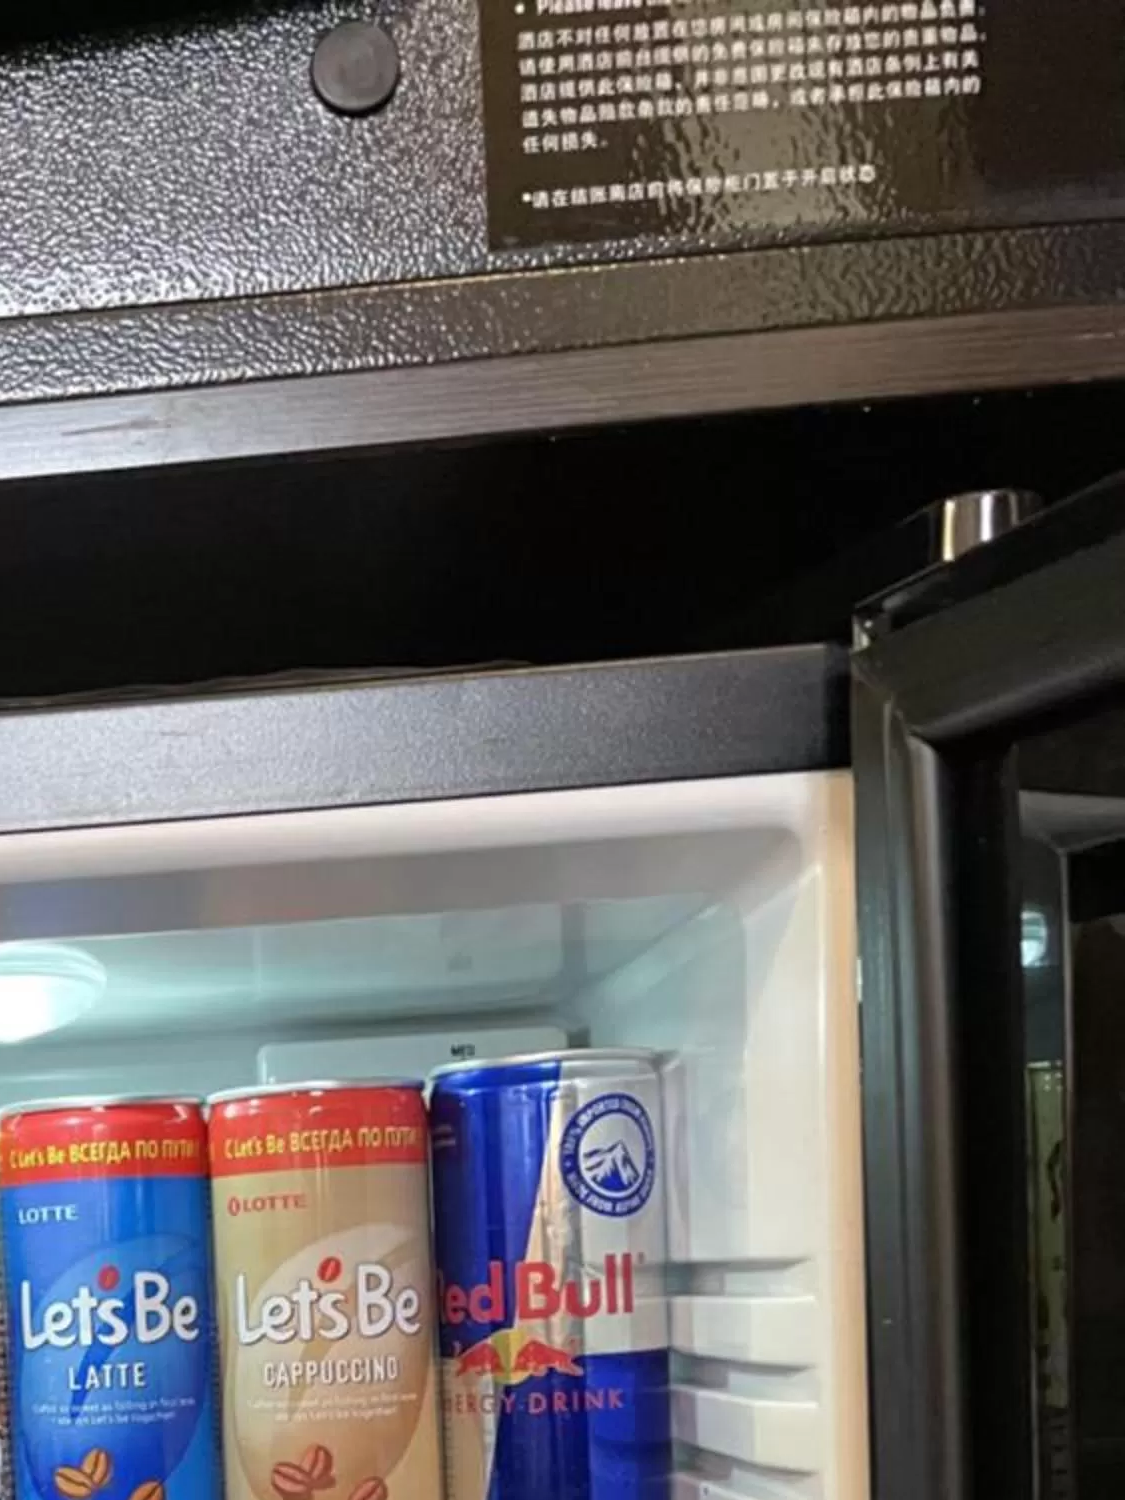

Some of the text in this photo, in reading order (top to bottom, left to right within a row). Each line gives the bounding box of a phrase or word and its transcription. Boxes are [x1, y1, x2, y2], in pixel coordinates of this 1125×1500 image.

[46, 1144, 67, 1165] Be
[69, 1139, 132, 1165] ВСЕГДА
[134, 1139, 159, 1160] ПО
[266, 1134, 285, 1154] Be
[289, 1128, 354, 1153] ВСЕГДА
[357, 1127, 382, 1147] ПО
[18, 1203, 80, 1225] LOTTE
[243, 1193, 308, 1213] LOTTE
[357, 1263, 421, 1338] Be
[439, 1253, 634, 1324] ed Bull
[133, 1270, 201, 1345] Be
[68, 1361, 148, 1392] LATTE
[263, 1355, 400, 1388] CAPPUCCINO
[528, 1387, 624, 1415] DRINK
